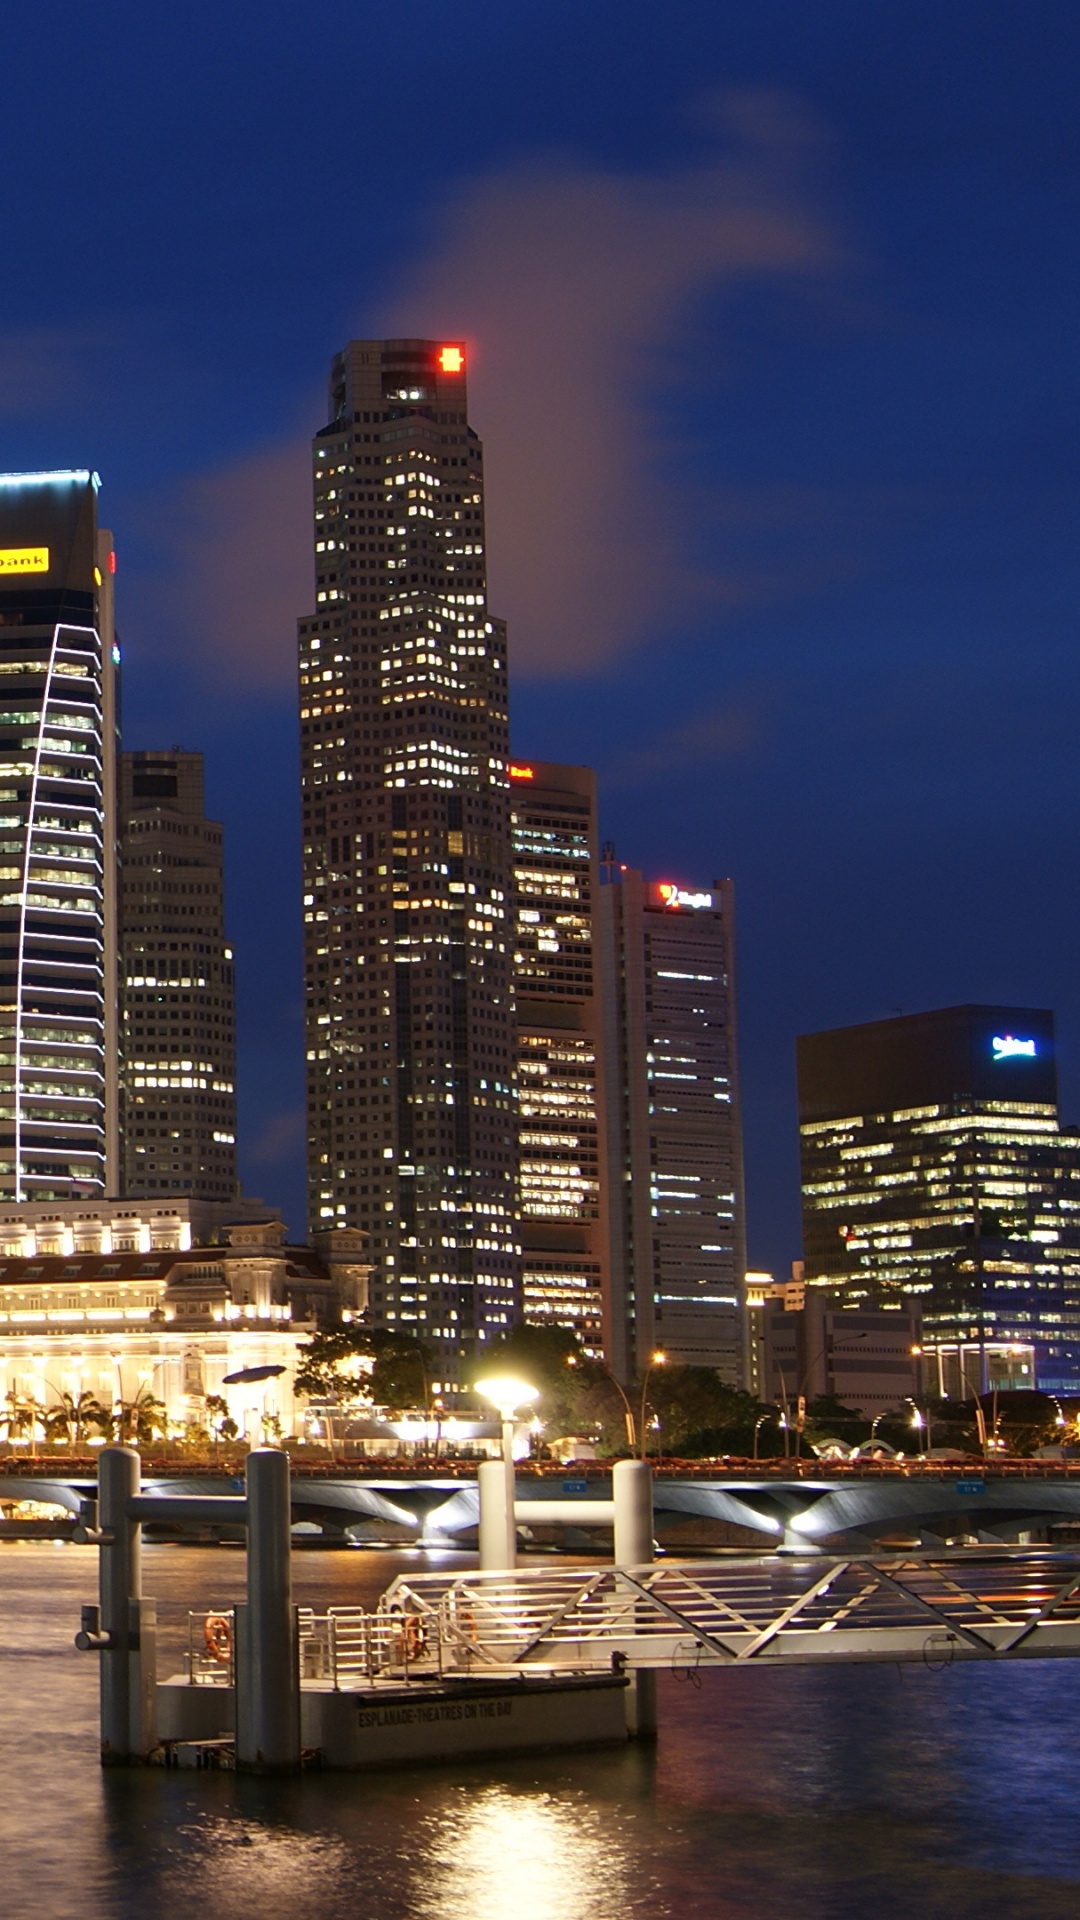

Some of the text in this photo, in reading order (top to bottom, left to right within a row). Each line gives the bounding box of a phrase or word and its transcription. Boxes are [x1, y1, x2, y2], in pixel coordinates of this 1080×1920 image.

[464, 1704, 477, 1719] ON
[479, 1703, 496, 1717] THE
[497, 1701, 513, 1716] BAY
